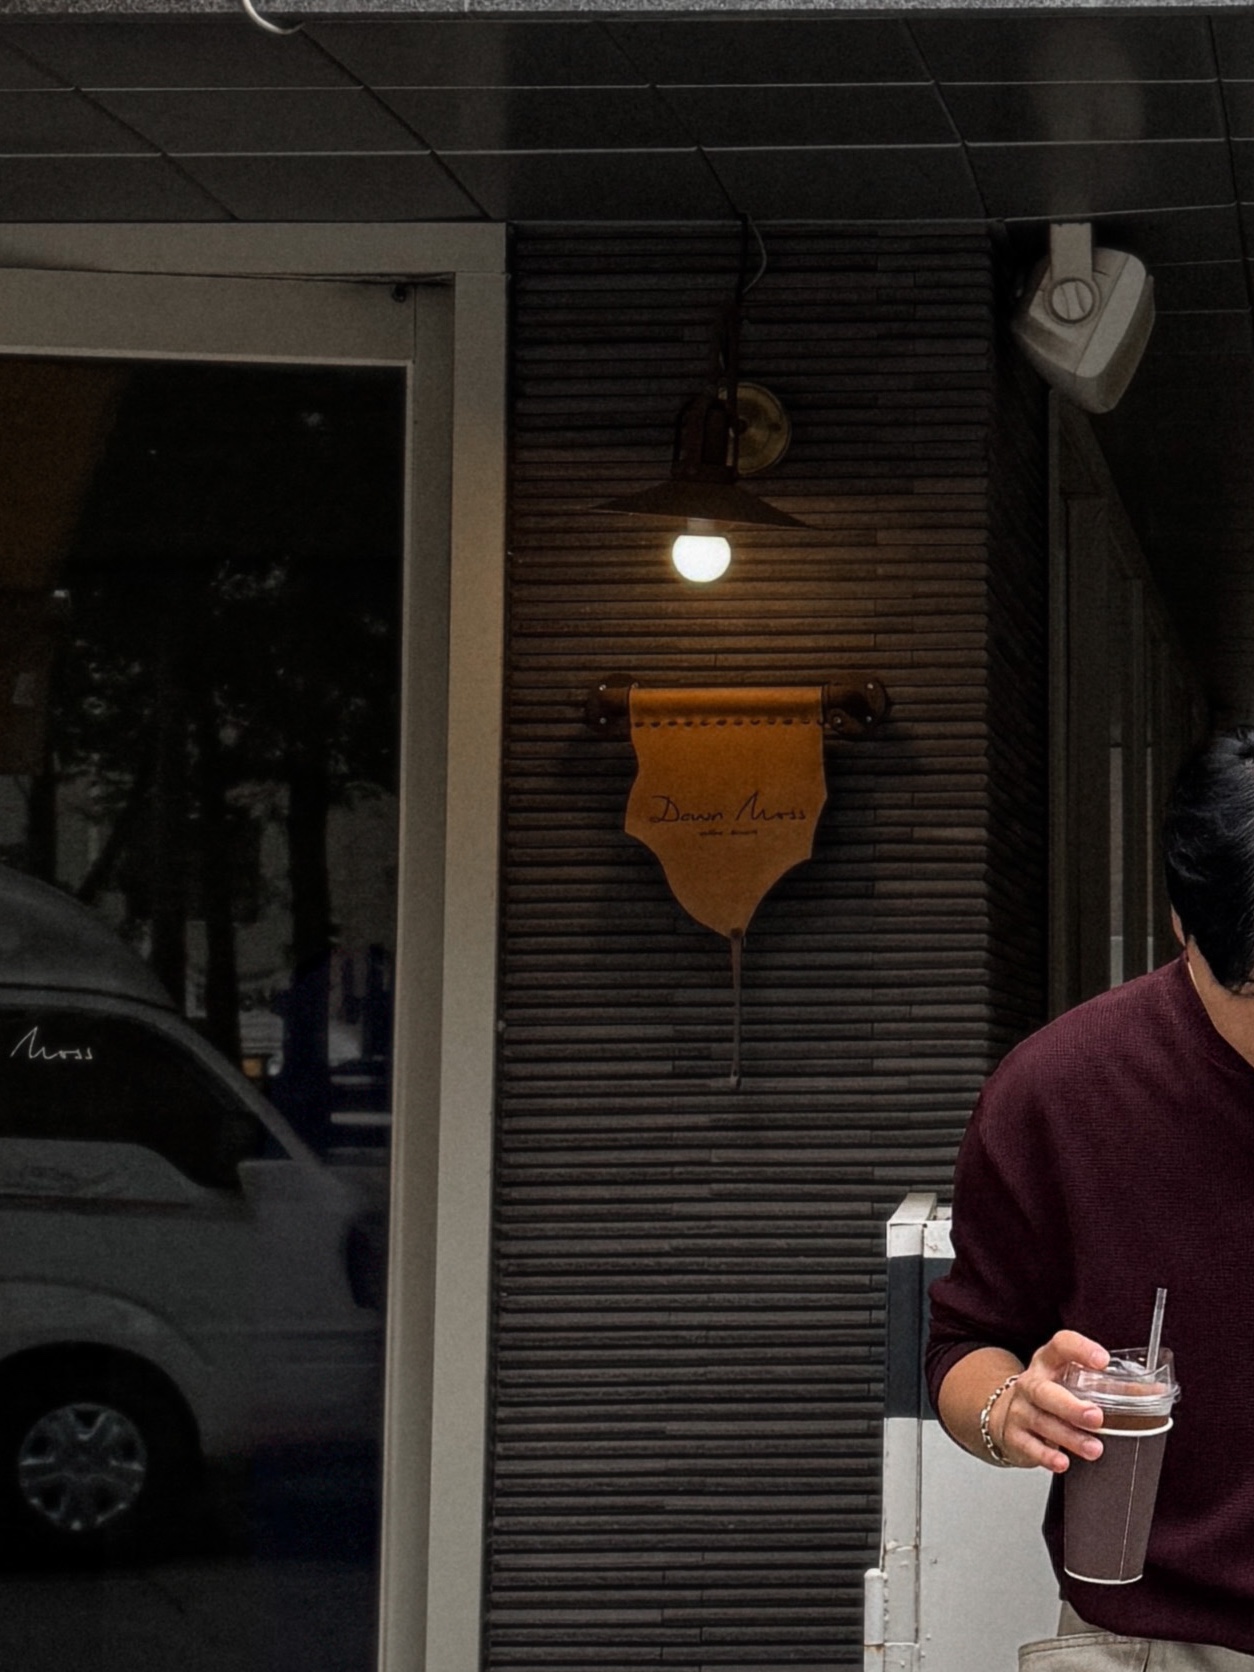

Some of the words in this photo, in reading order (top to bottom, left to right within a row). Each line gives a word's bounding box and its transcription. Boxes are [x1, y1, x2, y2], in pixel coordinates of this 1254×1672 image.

[650, 795, 723, 822] Dawn
[736, 791, 807, 821] Moss
[9, 1025, 94, 1061] Moss
